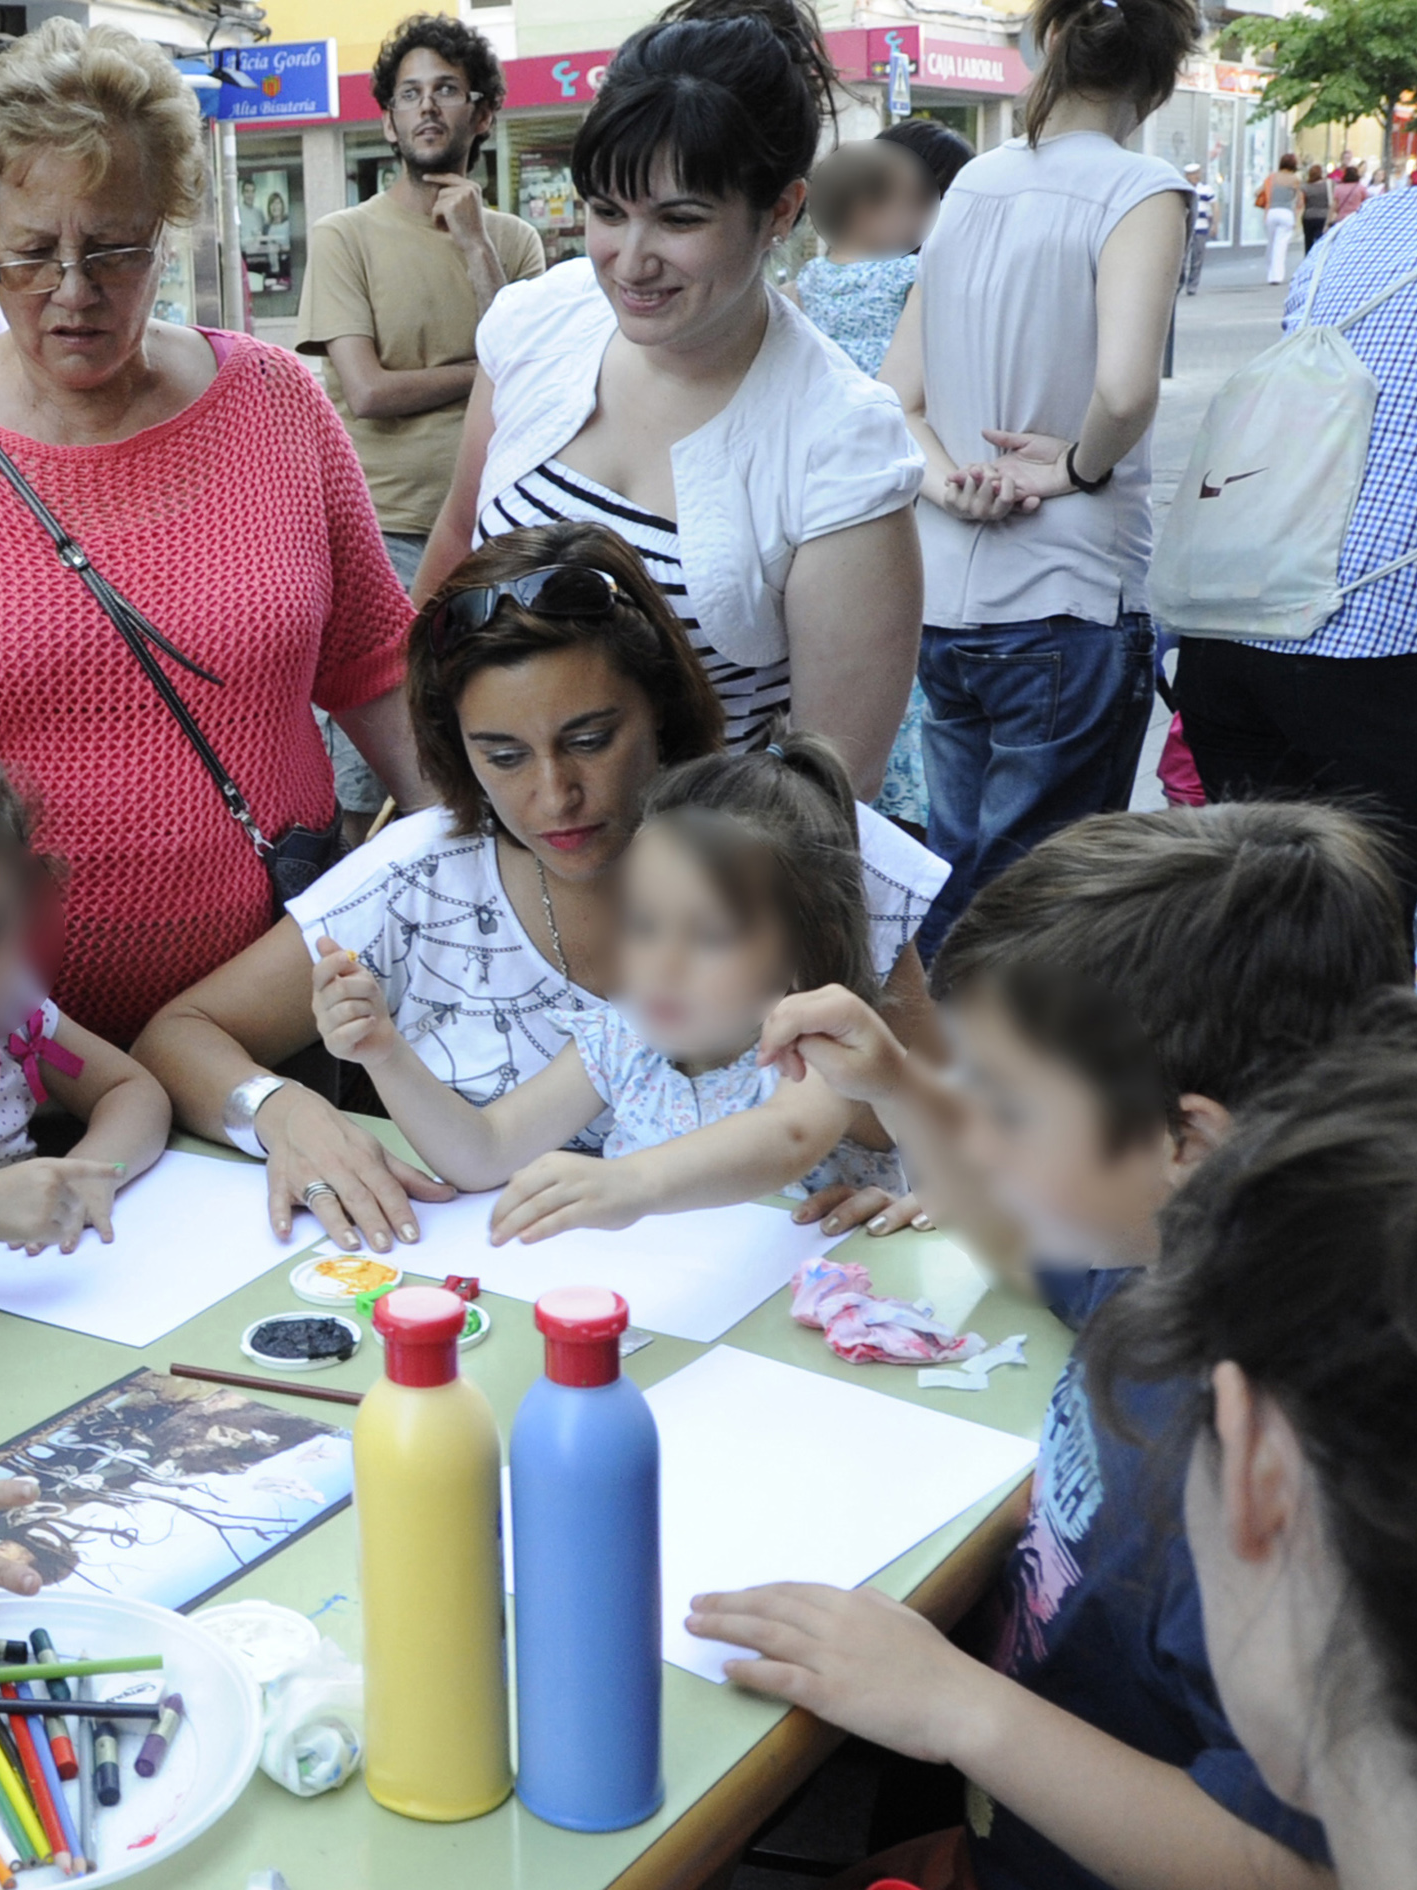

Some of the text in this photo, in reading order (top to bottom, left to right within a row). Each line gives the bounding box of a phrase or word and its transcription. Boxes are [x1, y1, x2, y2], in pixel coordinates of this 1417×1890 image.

[273, 46, 321, 74] Gordo
[927, 52, 955, 80] CAJA
[957, 55, 1005, 83] LABORAL
[230, 101, 257, 117] Alta
